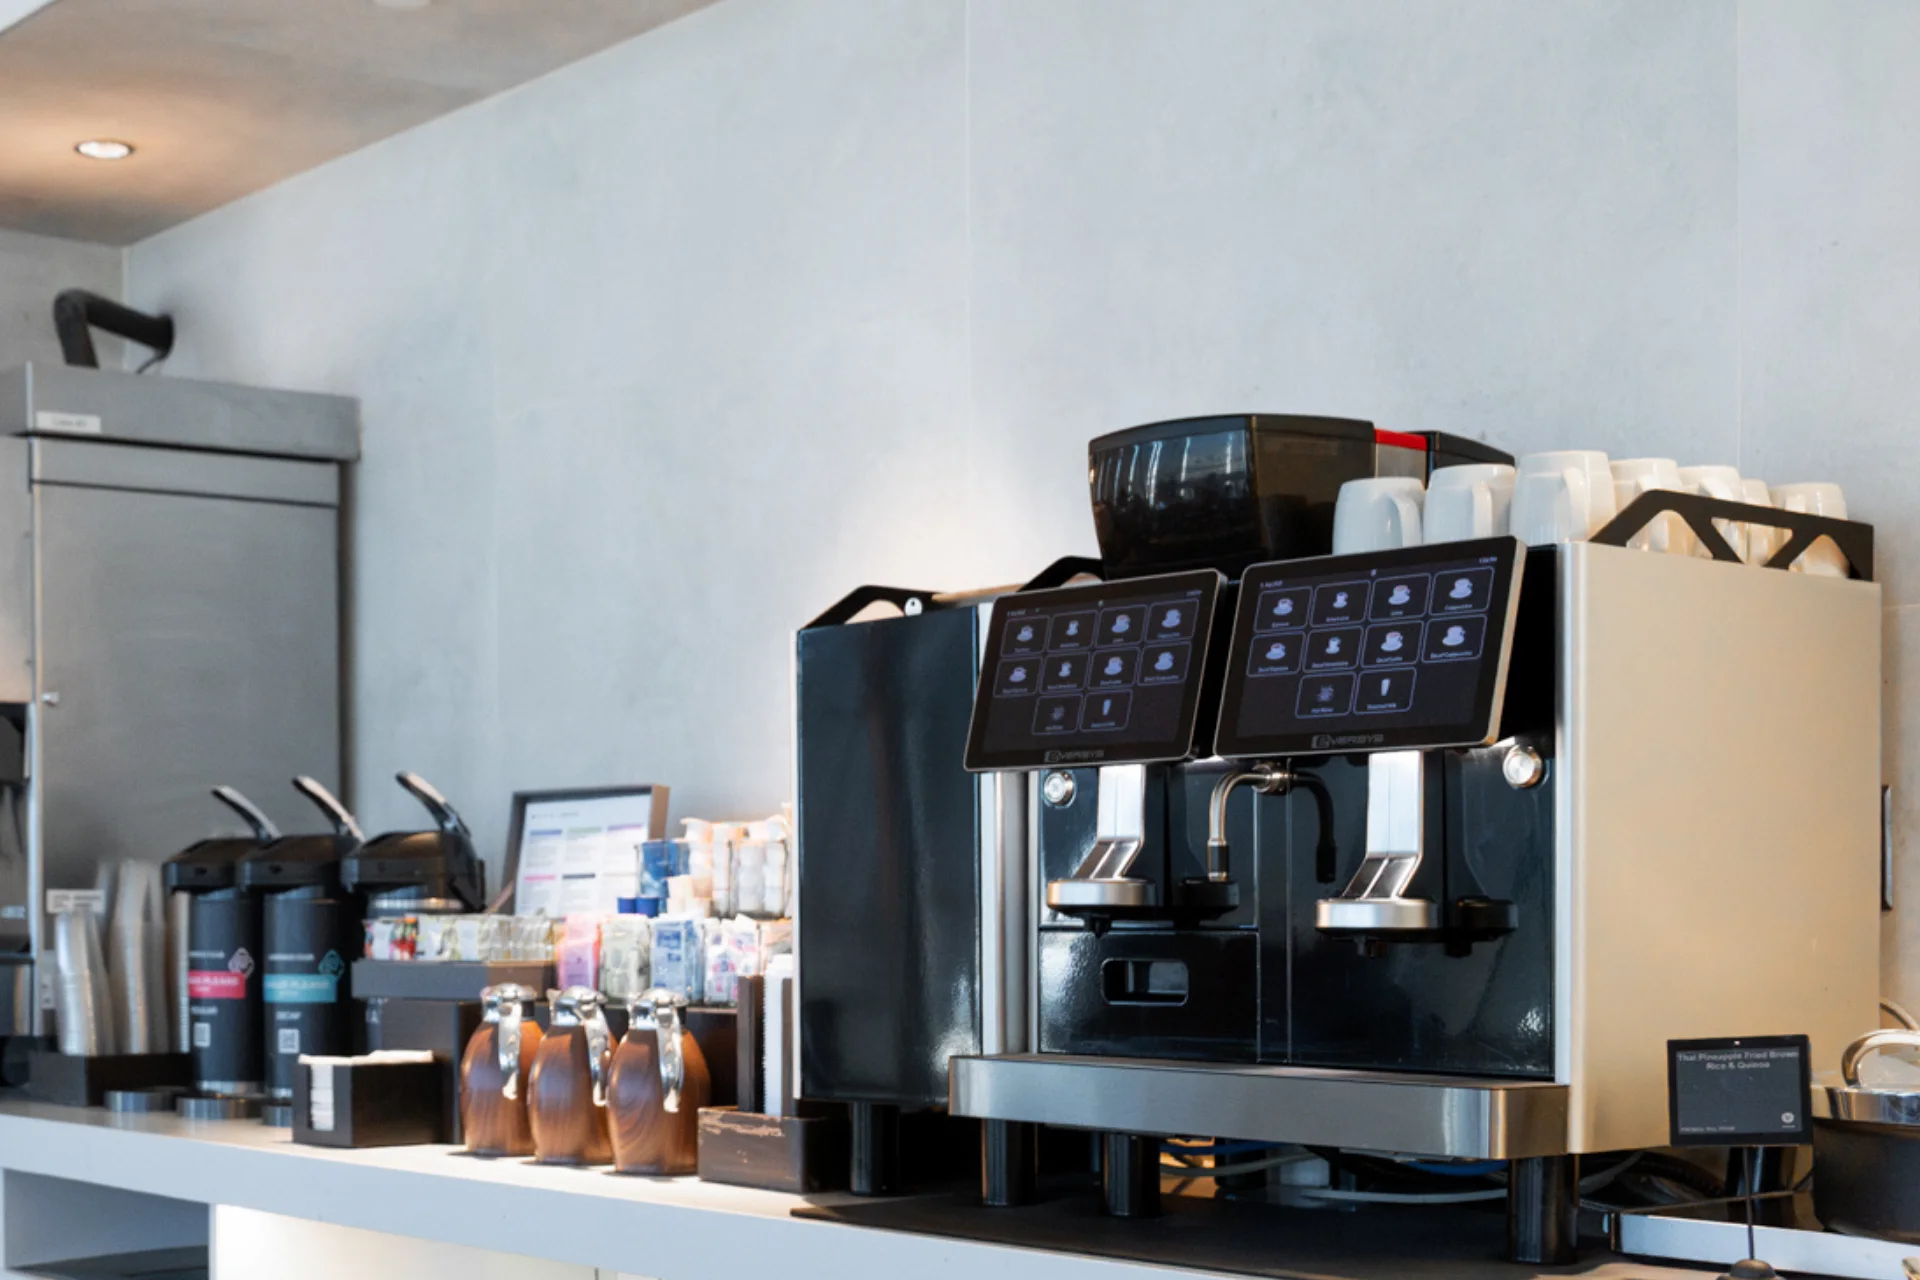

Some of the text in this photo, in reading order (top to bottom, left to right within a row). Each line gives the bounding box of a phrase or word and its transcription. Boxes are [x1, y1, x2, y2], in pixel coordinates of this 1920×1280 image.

[1677, 1050, 1799, 1062] Thai Pineapple Fried Brown
[1706, 1062, 1727, 1070] Rice
[1737, 1061, 1771, 1069] Quinoa
